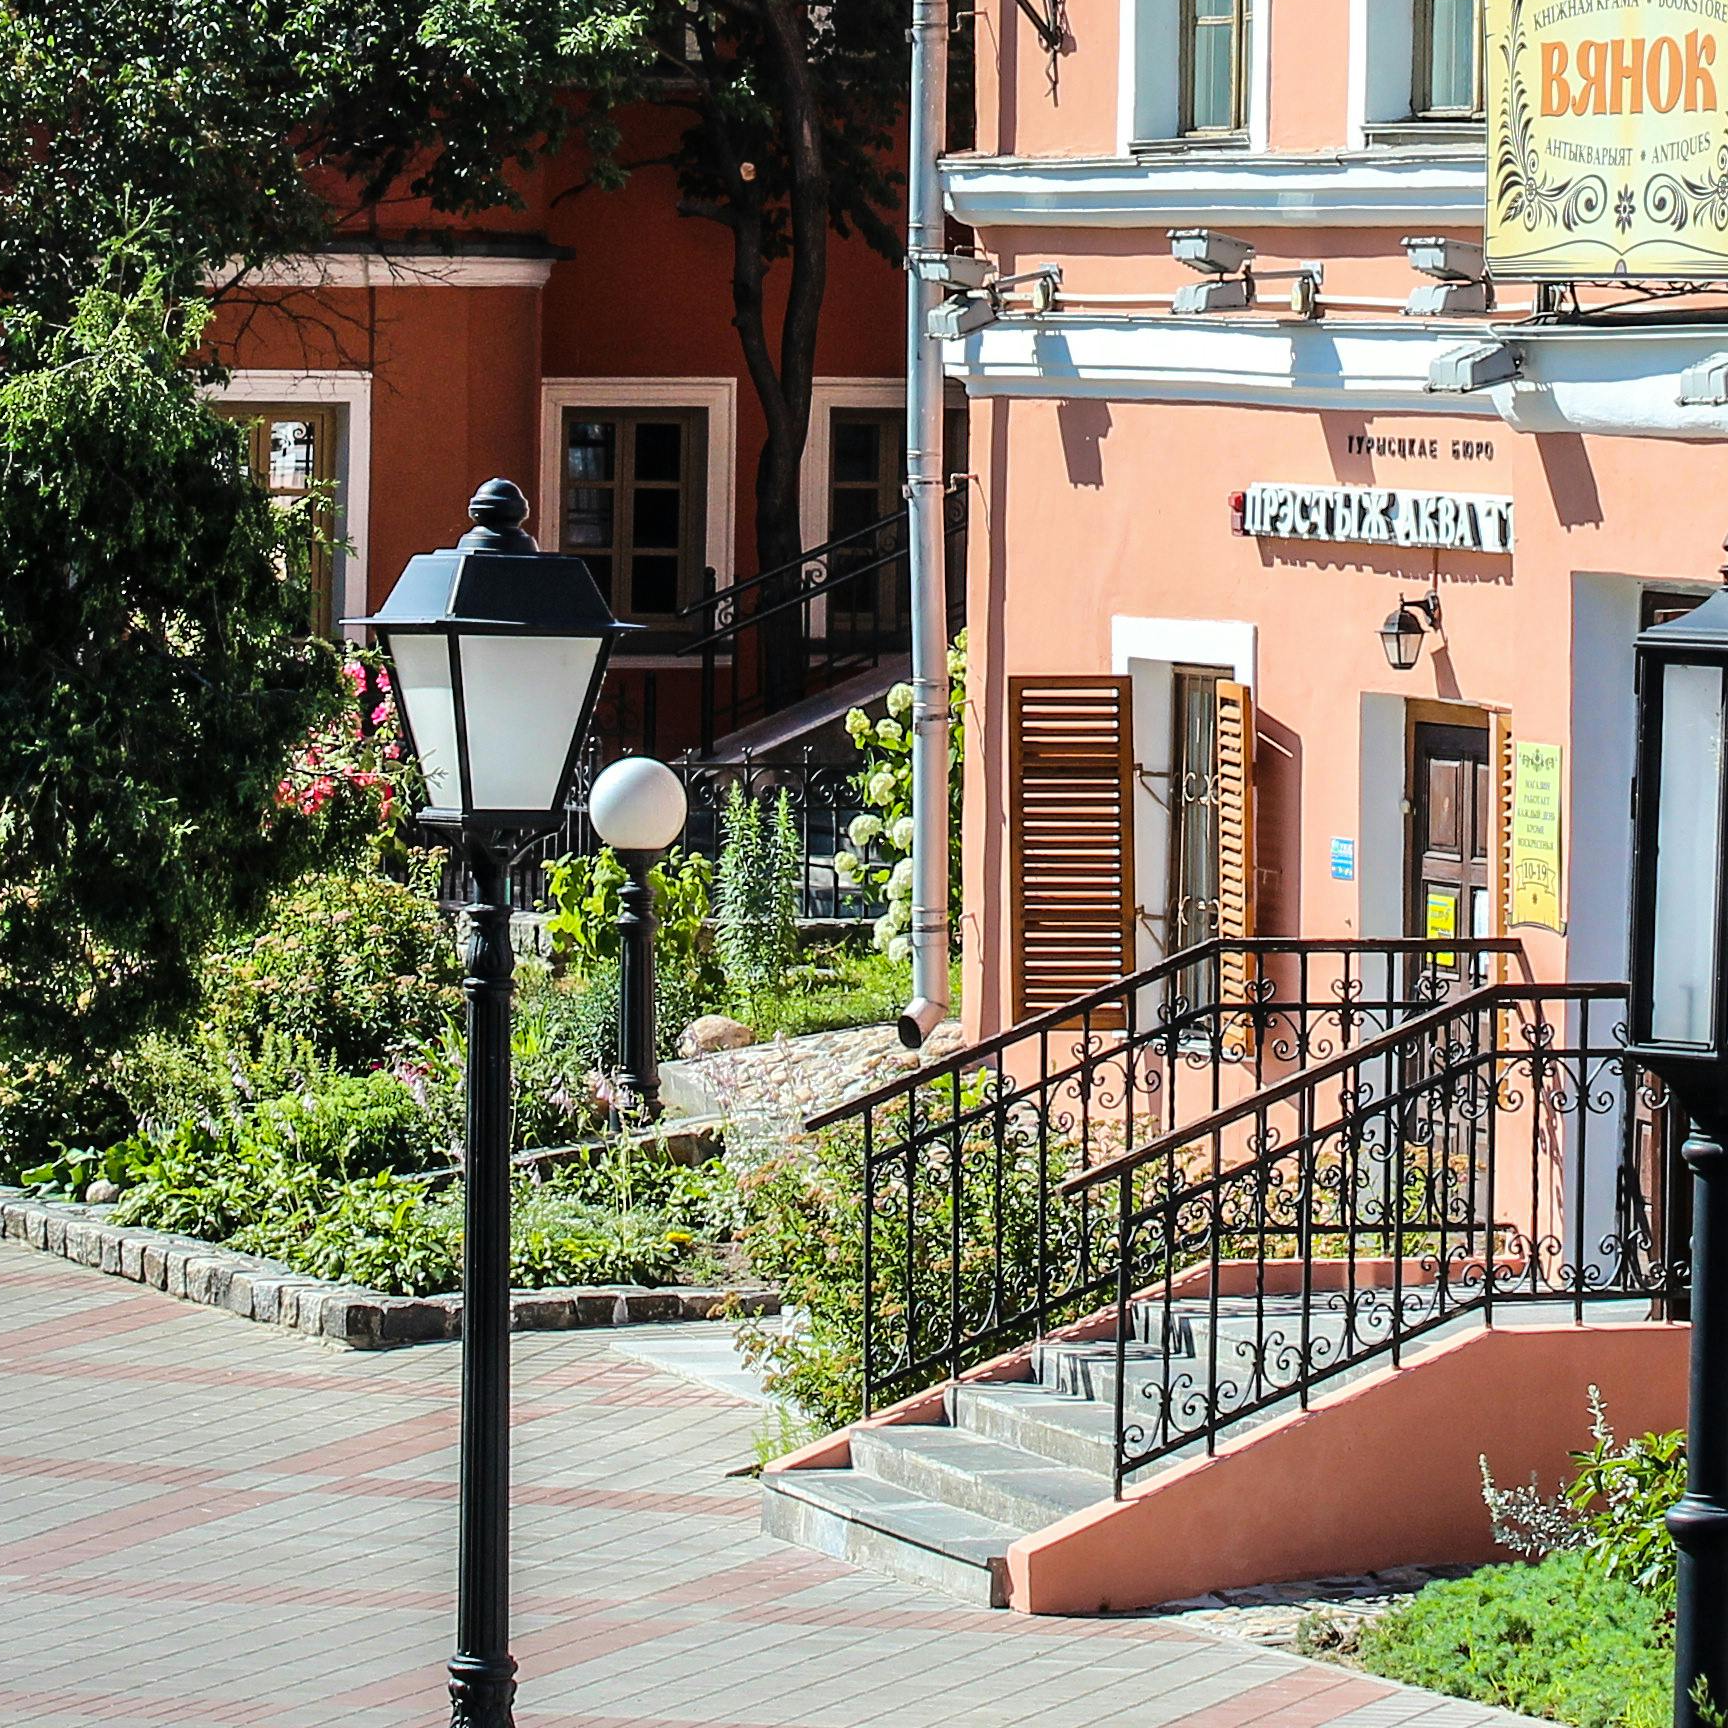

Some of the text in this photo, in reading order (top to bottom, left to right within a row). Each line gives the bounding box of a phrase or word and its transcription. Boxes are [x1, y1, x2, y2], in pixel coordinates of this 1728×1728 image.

[1540, 28, 1718, 117] ВЯНОК
[1545, 137, 1633, 167] АНТЫКВАРЫЯТ
[1651, 131, 1711, 165] ANTIQUES
[1347, 434, 1494, 461] ТУРЫСЦКАЕ БЮРО
[1244, 485, 1391, 542] ПРЭСТЫЖ
[1396, 492, 1474, 550] АКВА
[1524, 862, 1548, 881] 10-19
